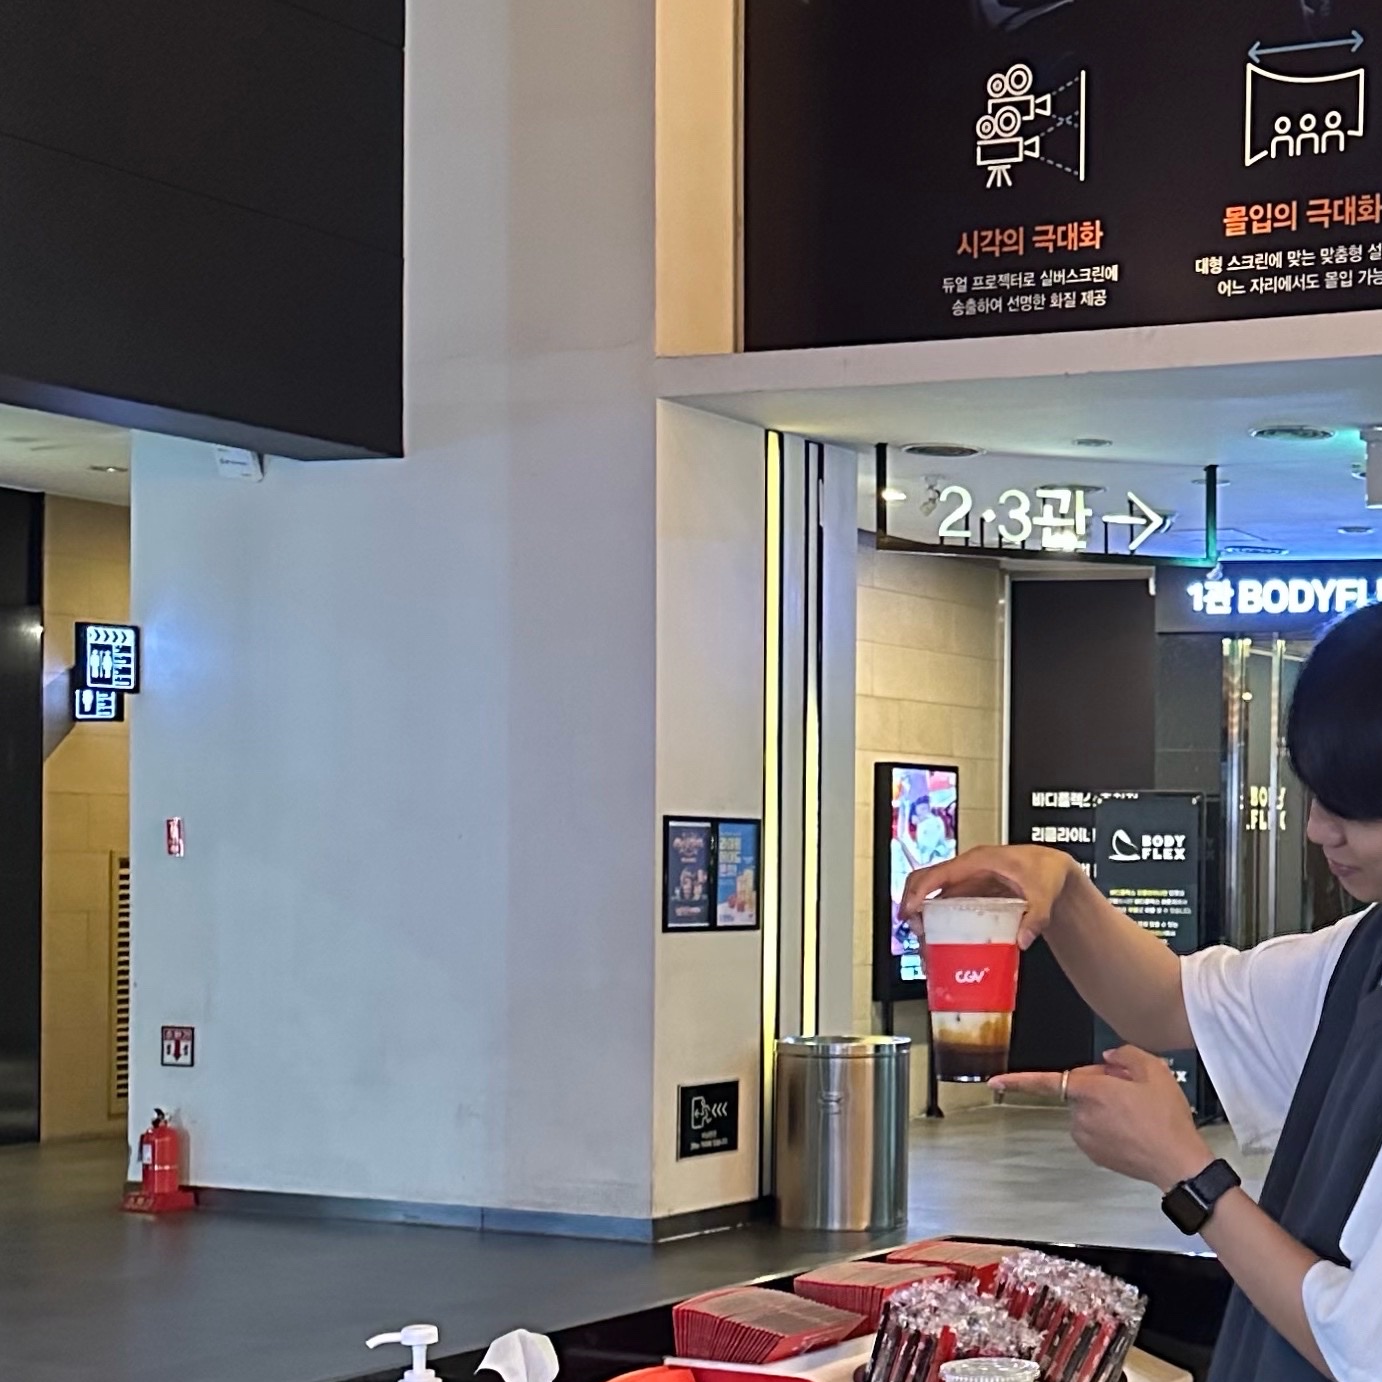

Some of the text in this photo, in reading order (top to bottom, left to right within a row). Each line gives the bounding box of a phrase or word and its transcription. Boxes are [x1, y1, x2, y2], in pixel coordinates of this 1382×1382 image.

[1223, 200, 1298, 237] 몰입의
[956, 220, 1104, 259] 시각의 극대화
[1195, 256, 1223, 275] 대형
[1226, 251, 1283, 271] 스크린에
[1287, 249, 1316, 268] 맞는
[1320, 244, 1363, 265] 맞춤형
[942, 264, 1119, 294] 듀얼 프로젝터로 실버스크린에
[1217, 280, 1246, 297] 어느
[1250, 274, 1320, 294] 자리에서도
[1324, 269, 1353, 289] 몰입
[952, 289, 1107, 316] 송출하여 선명한 화질 제공
[1186, 578, 1235, 614] 1관
[1141, 834, 1186, 847] BODY
[1141, 848, 1186, 861] FLEX
[955, 968, 985, 984] CGV
